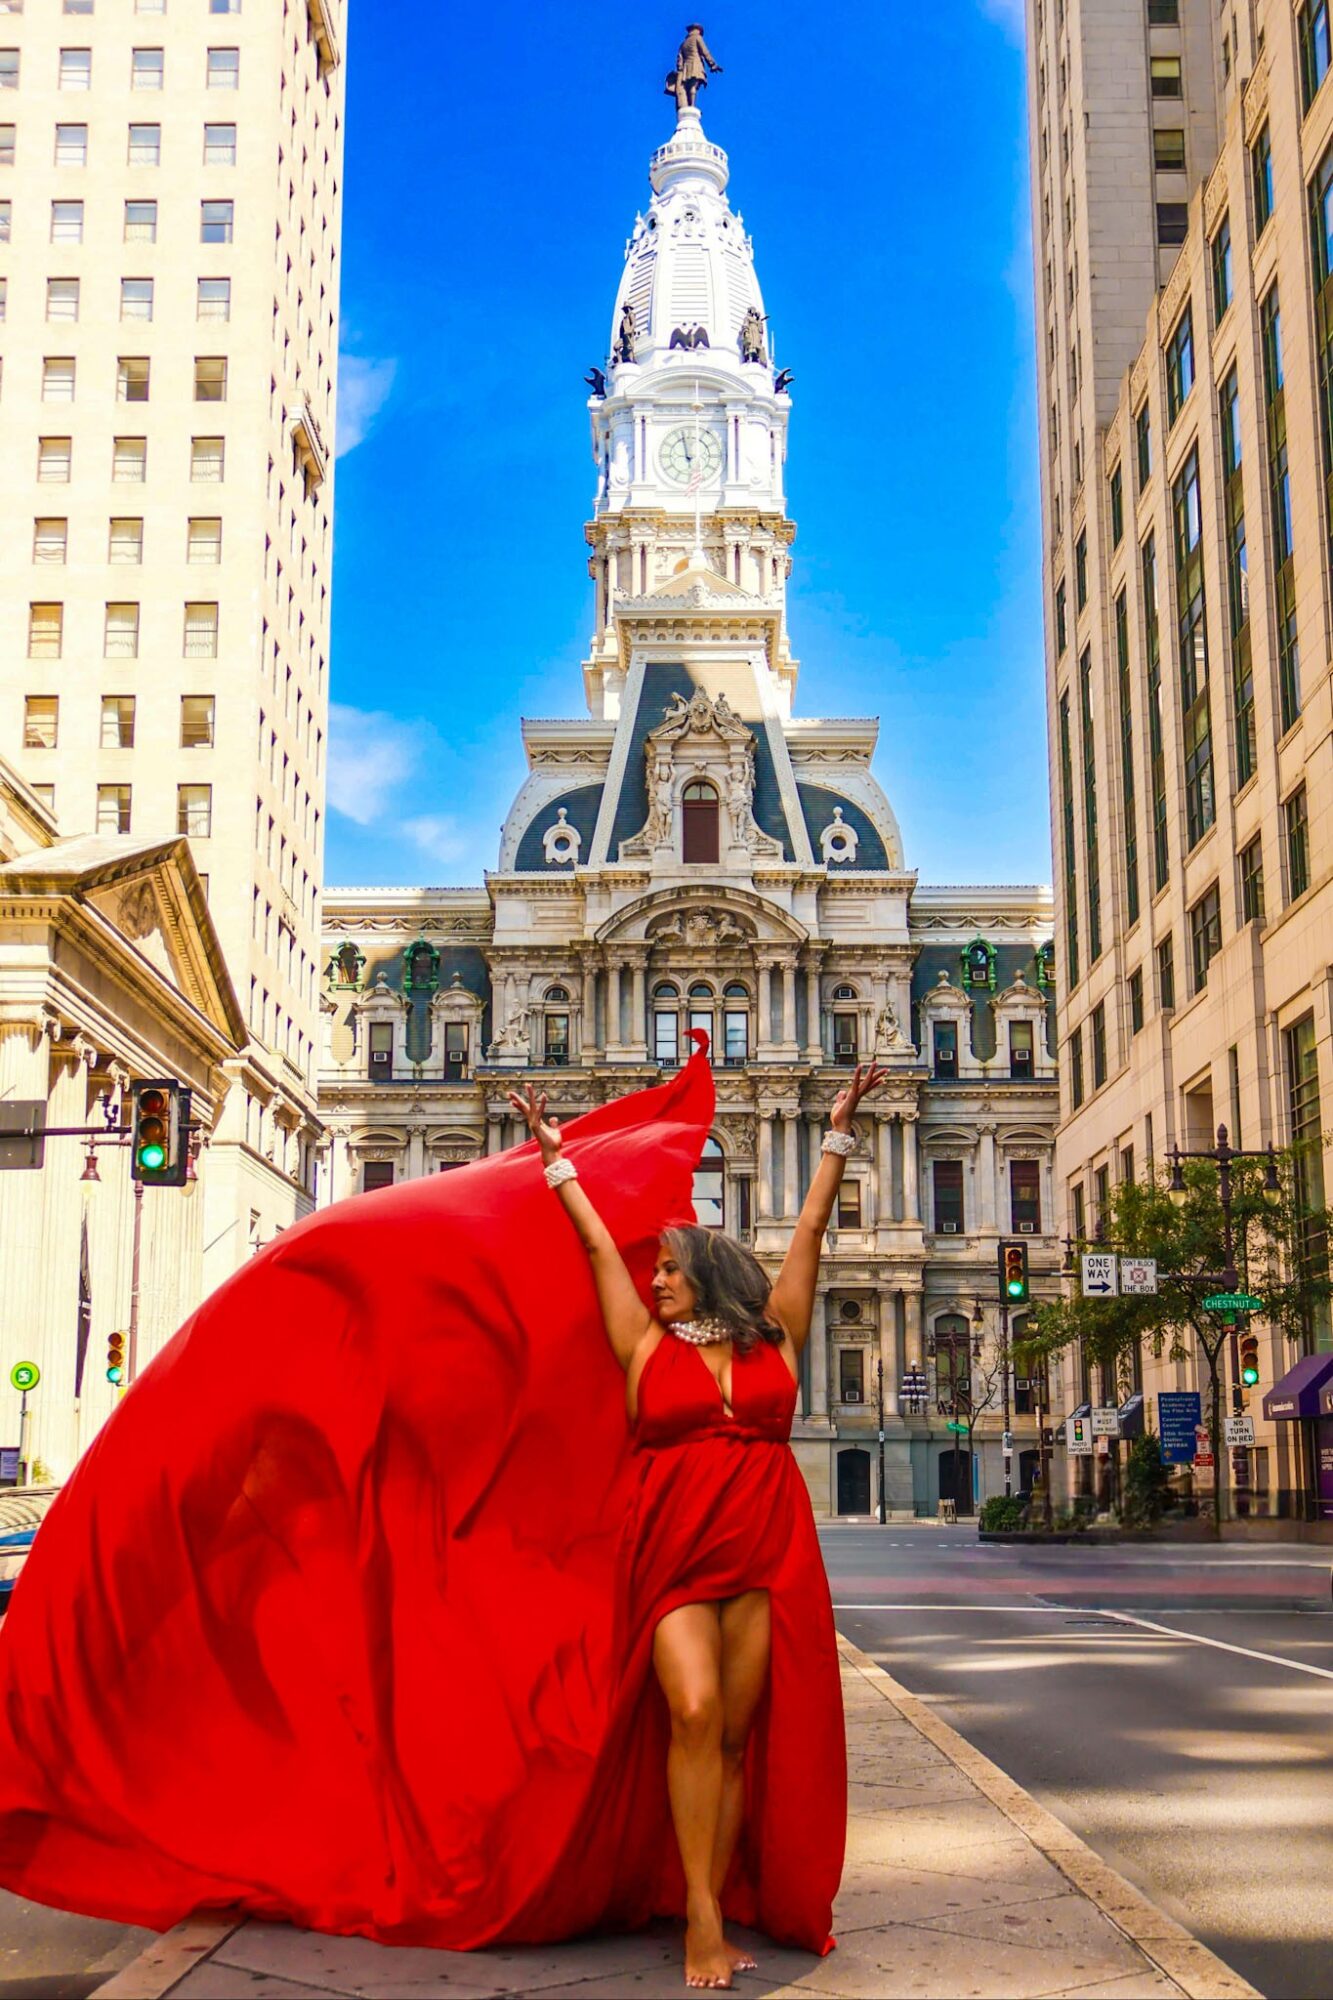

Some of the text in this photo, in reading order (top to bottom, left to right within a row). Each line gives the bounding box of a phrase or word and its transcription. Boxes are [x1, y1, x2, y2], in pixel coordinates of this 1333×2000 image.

[1088, 1258, 1109, 1267] ONE
[1088, 1269, 1111, 1278] WAY
[1205, 1300, 1250, 1308] CHESTNUT
